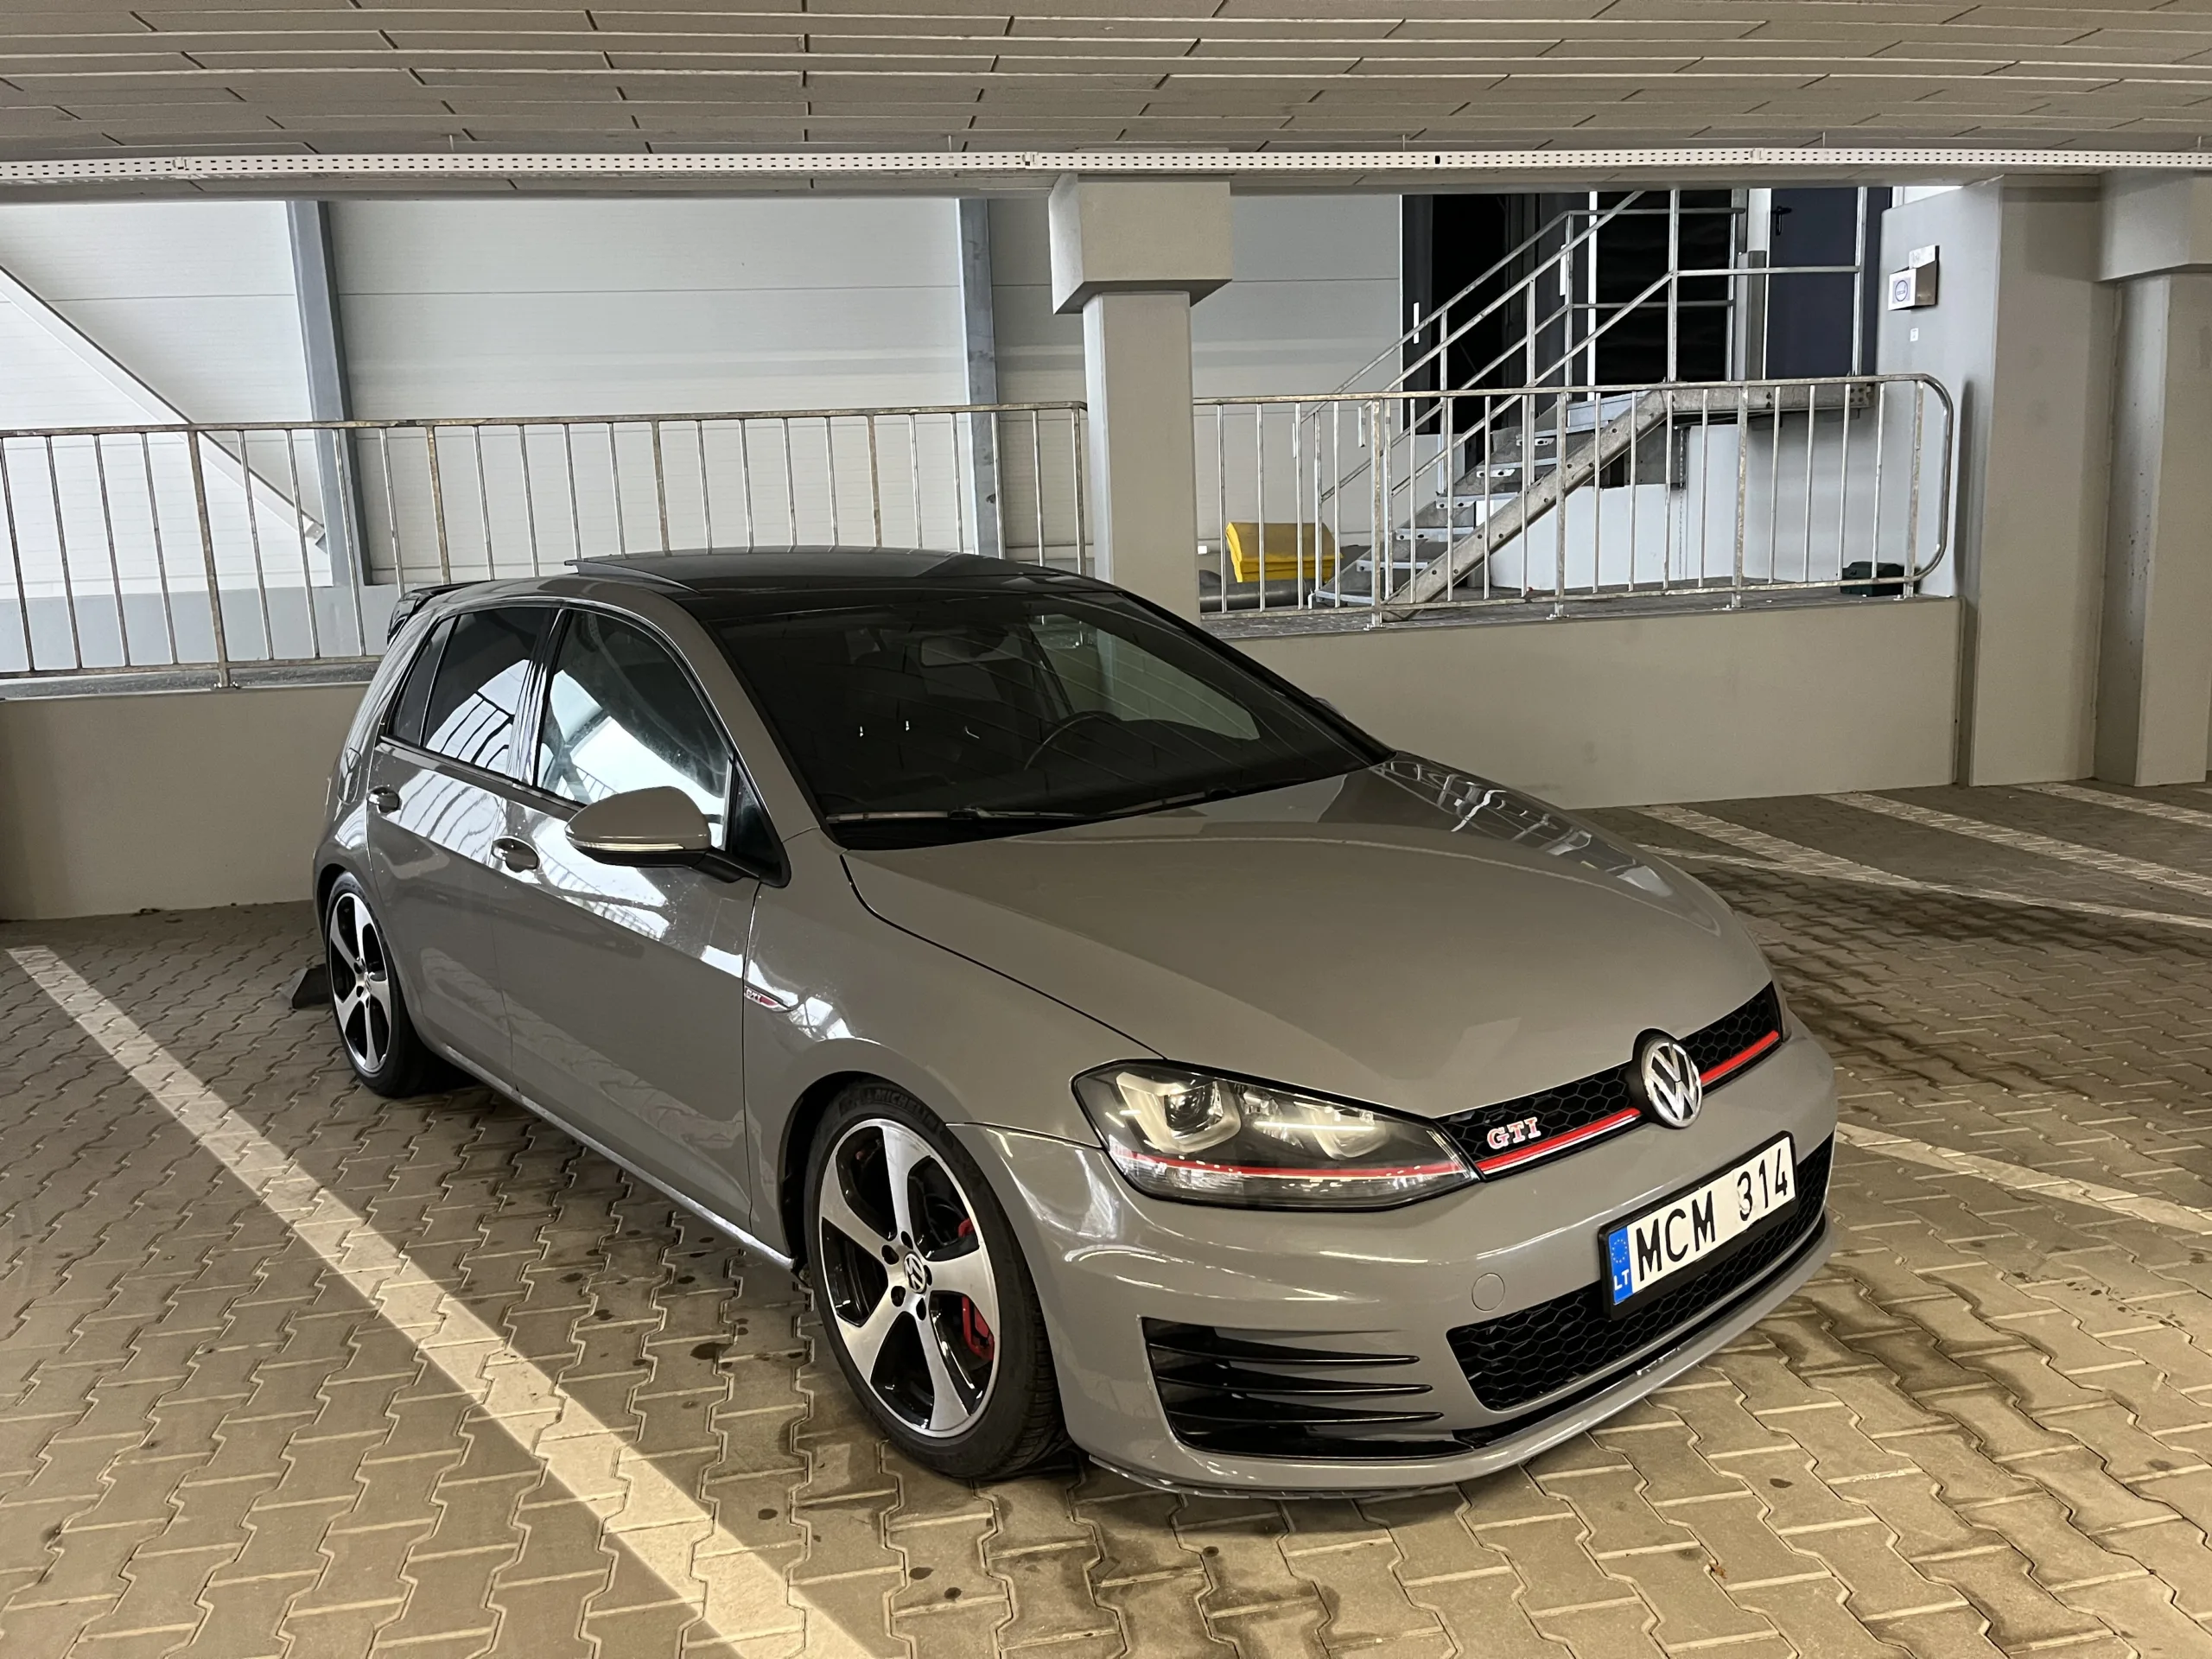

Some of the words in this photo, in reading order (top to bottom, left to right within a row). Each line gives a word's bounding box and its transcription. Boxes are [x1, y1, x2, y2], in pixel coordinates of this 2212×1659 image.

[874, 1088, 940, 1133] MICHELIN
[1486, 1116, 1541, 1150] GTI
[1636, 1190, 1716, 1282] MCM
[1737, 1147, 1788, 1222] 314
[1613, 1269, 1630, 1291] LT
